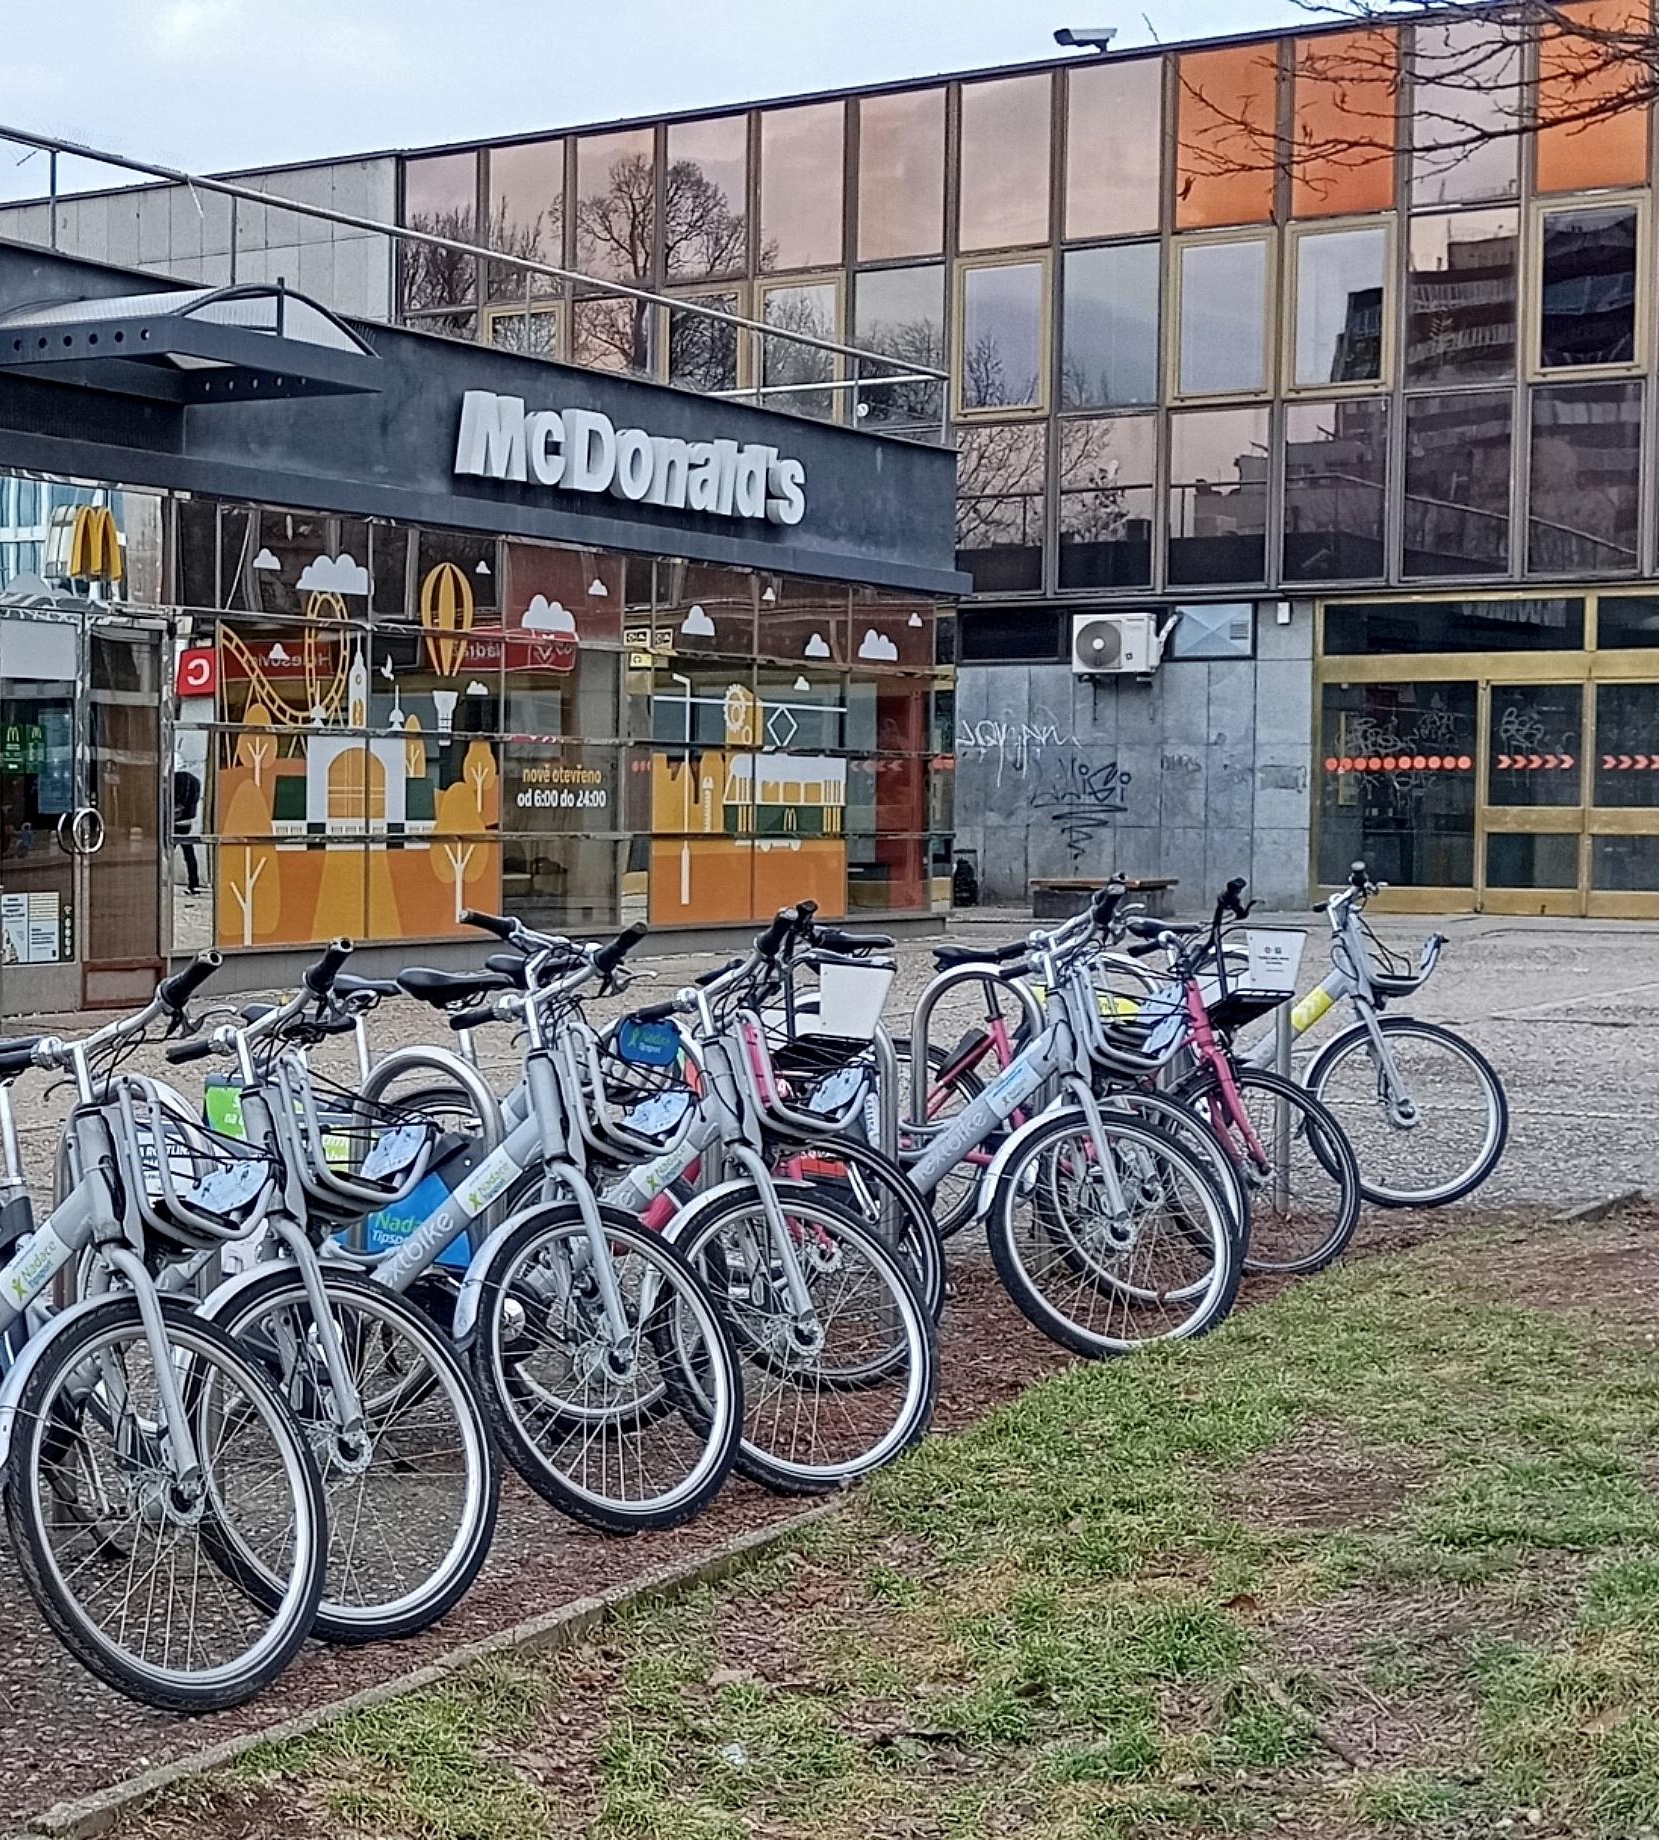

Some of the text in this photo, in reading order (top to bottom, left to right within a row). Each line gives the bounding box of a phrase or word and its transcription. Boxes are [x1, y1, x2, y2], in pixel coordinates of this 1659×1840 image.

[454, 390, 805, 525] McDonald's
[523, 763, 602, 784] nově otevřeno
[517, 788, 607, 808] od 6:00 do 24:00
[375, 1212, 422, 1232] Nad
[372, 1229, 406, 1246] Tipsp
[379, 1212, 454, 1290] extbike
[21, 1241, 57, 1283] Nadace
